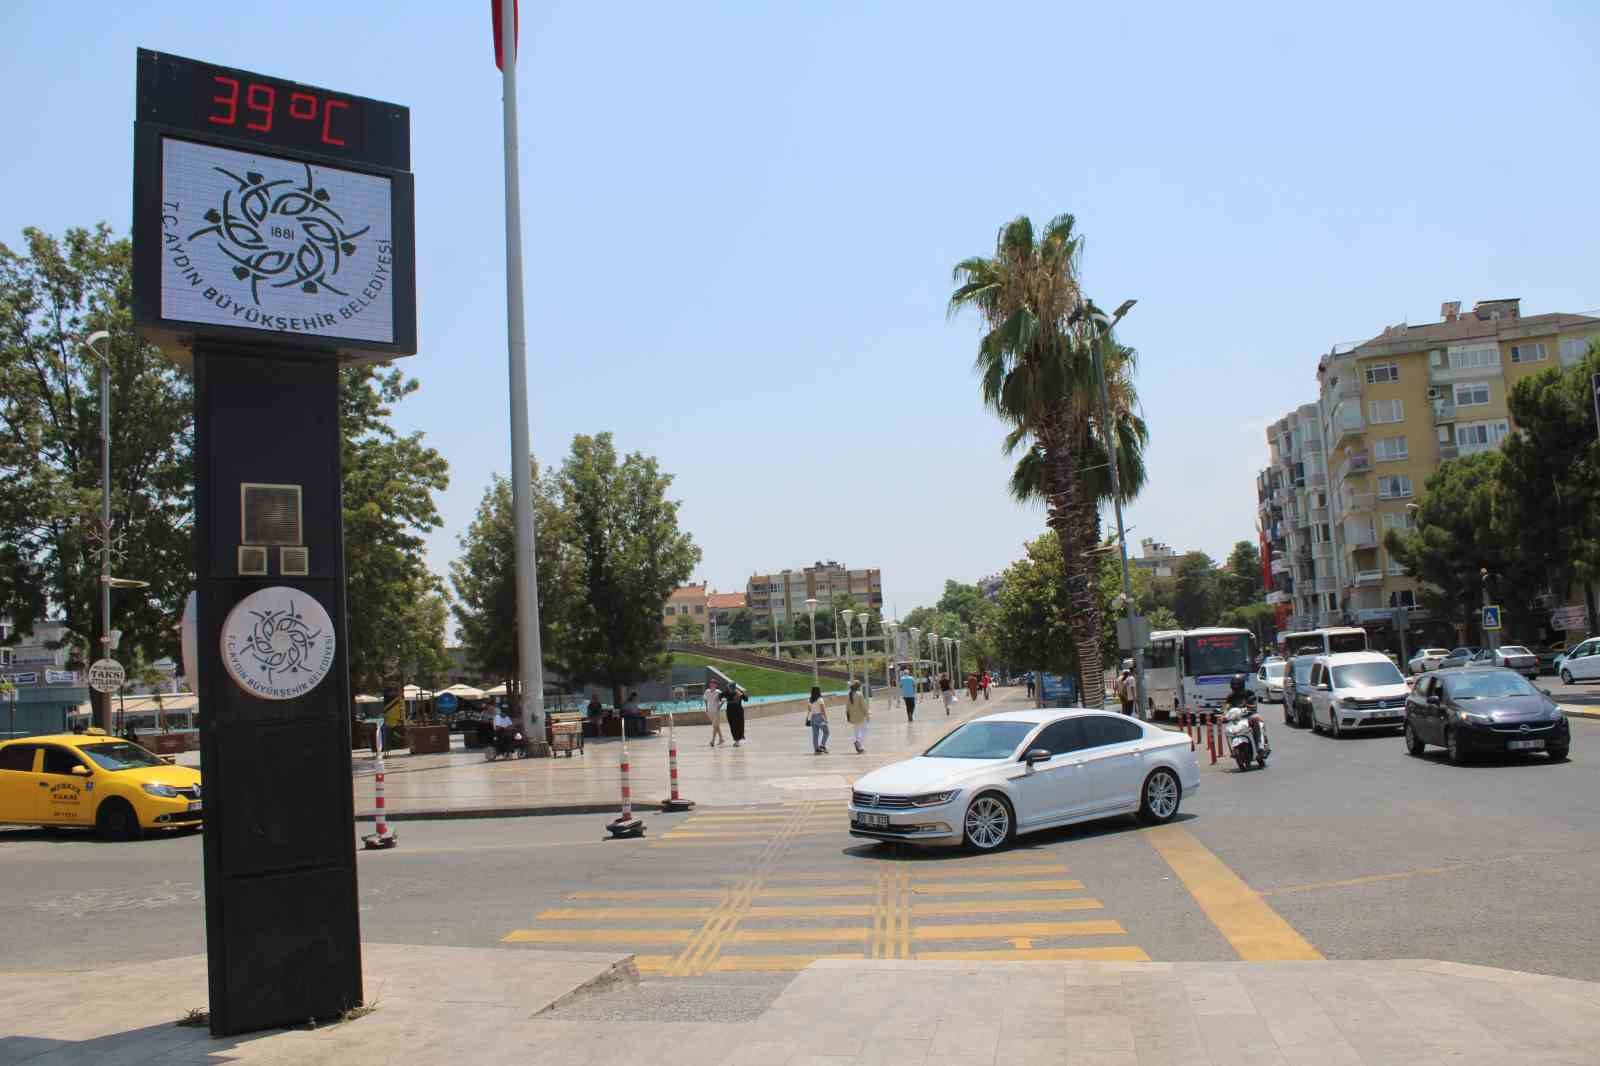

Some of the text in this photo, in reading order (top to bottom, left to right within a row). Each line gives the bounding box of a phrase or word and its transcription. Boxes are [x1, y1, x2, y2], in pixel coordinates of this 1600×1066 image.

[271, 226, 295, 241] 1881
[202, 286, 338, 331] BÜYÜKŞEHİR
[338, 239, 393, 320] BELEDİYESİ
